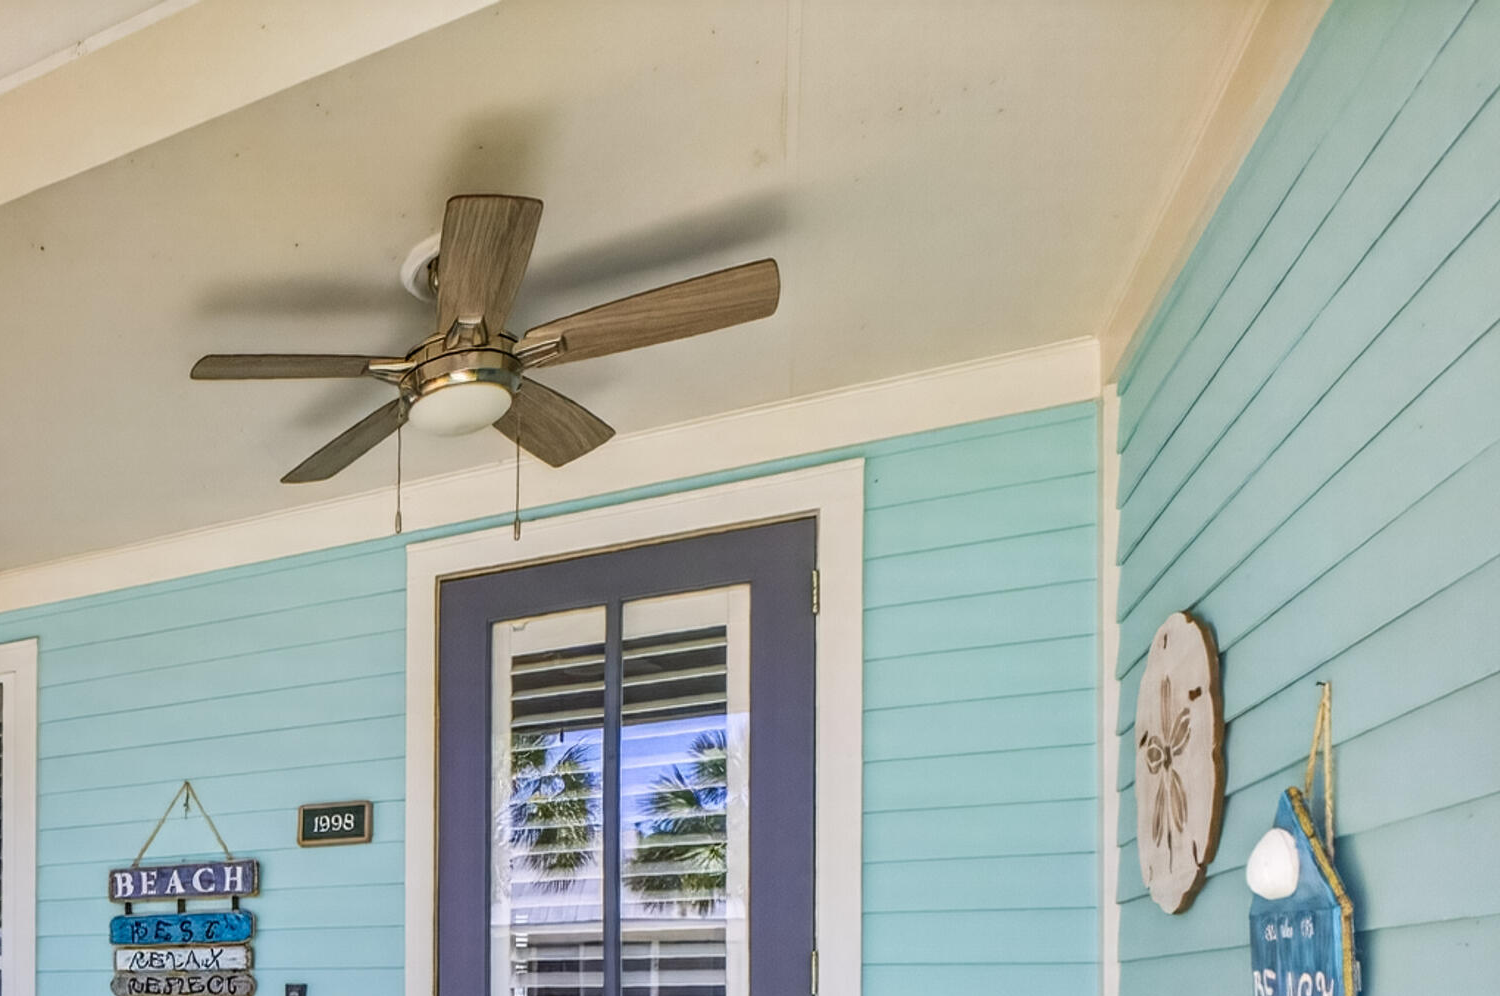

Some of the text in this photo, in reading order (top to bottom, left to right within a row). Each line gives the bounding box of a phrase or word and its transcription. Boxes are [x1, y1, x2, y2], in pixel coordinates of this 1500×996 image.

[313, 813, 355, 832] 1998
[113, 866, 243, 898] BEACH
[128, 948, 224, 970] RELAX
